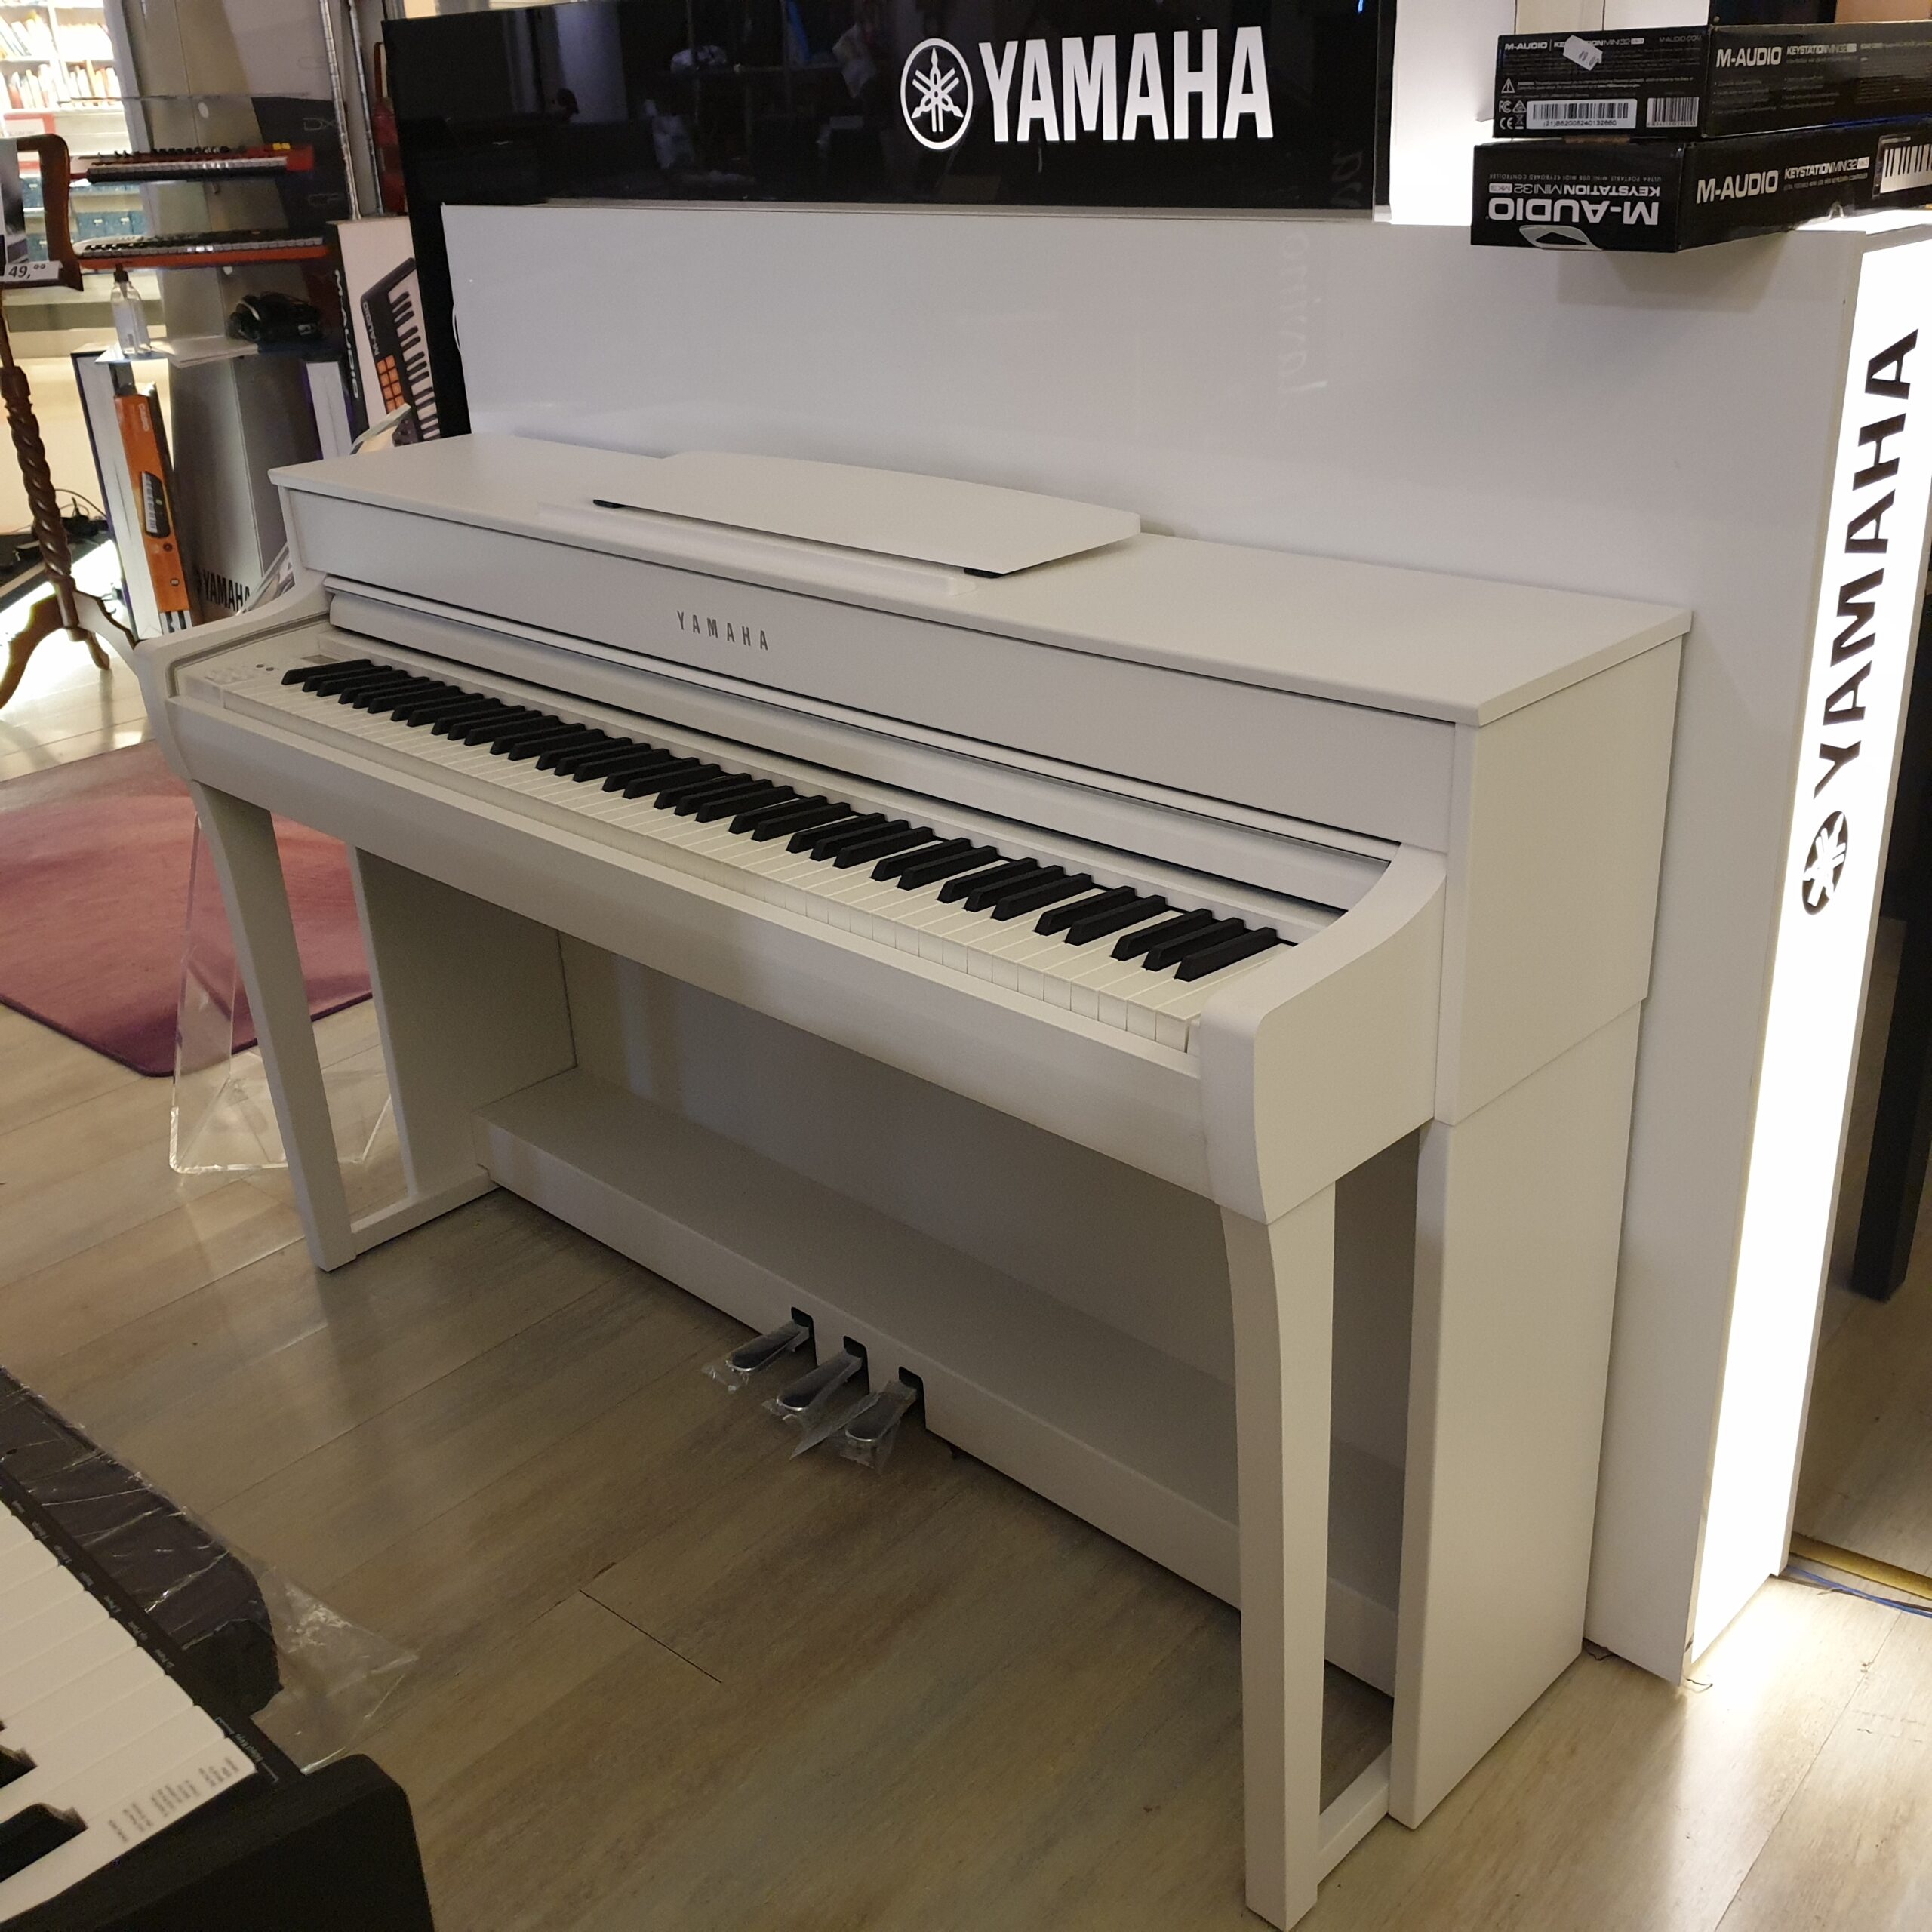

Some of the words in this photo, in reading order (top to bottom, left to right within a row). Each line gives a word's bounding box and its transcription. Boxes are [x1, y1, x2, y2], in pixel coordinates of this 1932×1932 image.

[1504, 42, 1548, 51] M-AUDIO
[1715, 47, 1782, 67] M-AUDIO
[979, 26, 1274, 143] YAMAHA
[1564, 184, 1660, 197] KEYSTATION
[1697, 170, 1778, 204] M-AUDIO
[1488, 198, 1659, 226] M-AUDIO
[334, 269, 359, 399] M-AUDIO
[1814, 328, 1918, 800] YAMAHA
[676, 610, 768, 651] YAMAHA
